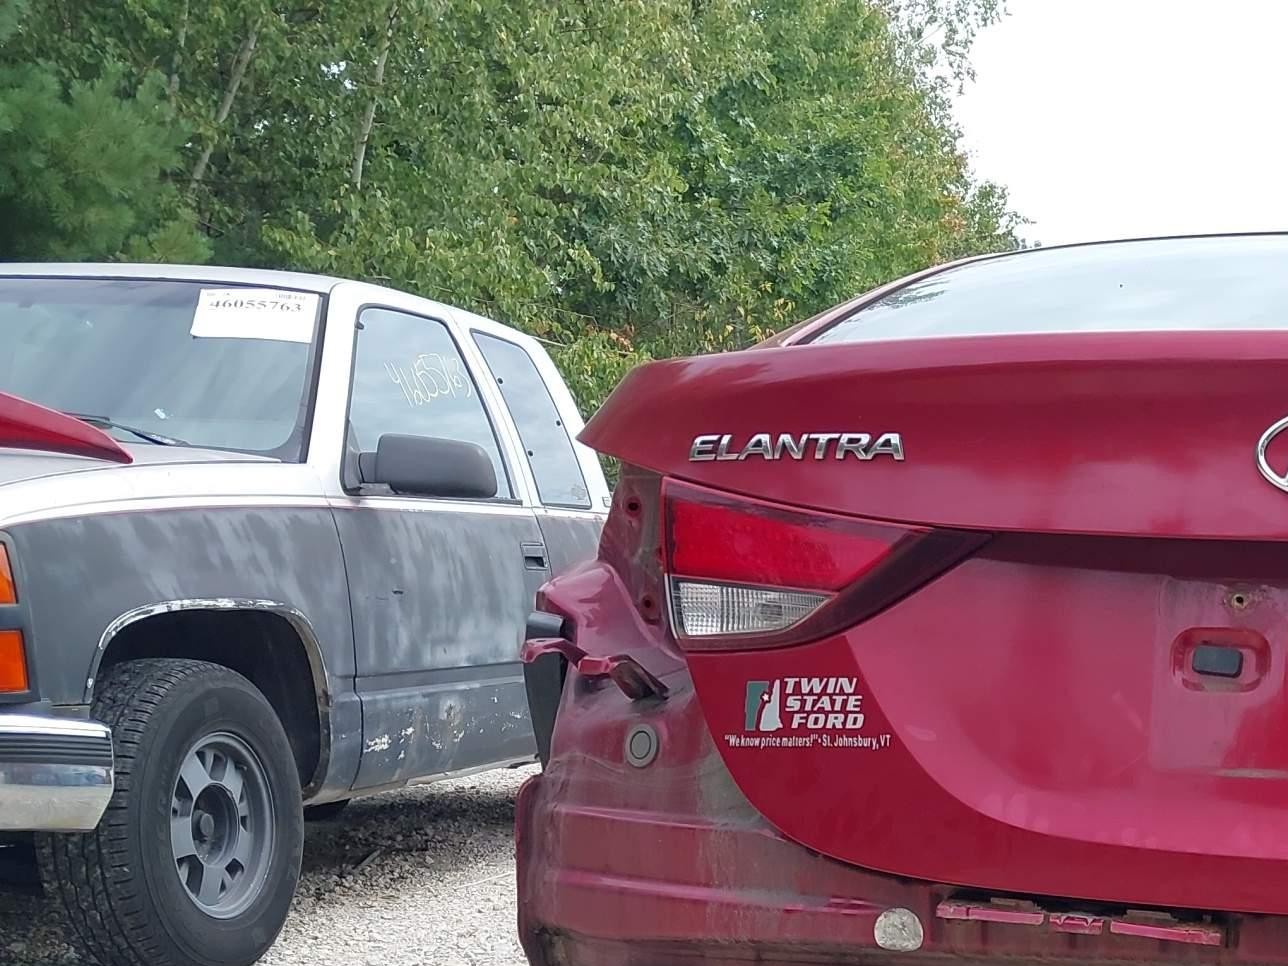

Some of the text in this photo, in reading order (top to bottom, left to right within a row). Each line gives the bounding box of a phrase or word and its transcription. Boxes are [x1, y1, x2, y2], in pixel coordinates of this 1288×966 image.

[209, 299, 302, 312] 46055763
[689, 433, 905, 461] ELANTRA
[784, 677, 857, 693] TWIN
[785, 695, 862, 711] STATE
[791, 713, 864, 729] FORD
[740, 735, 760, 747] know
[760, 734, 780, 750] price
[834, 734, 879, 750] Johnsbury,
[880, 734, 891, 747] VT
